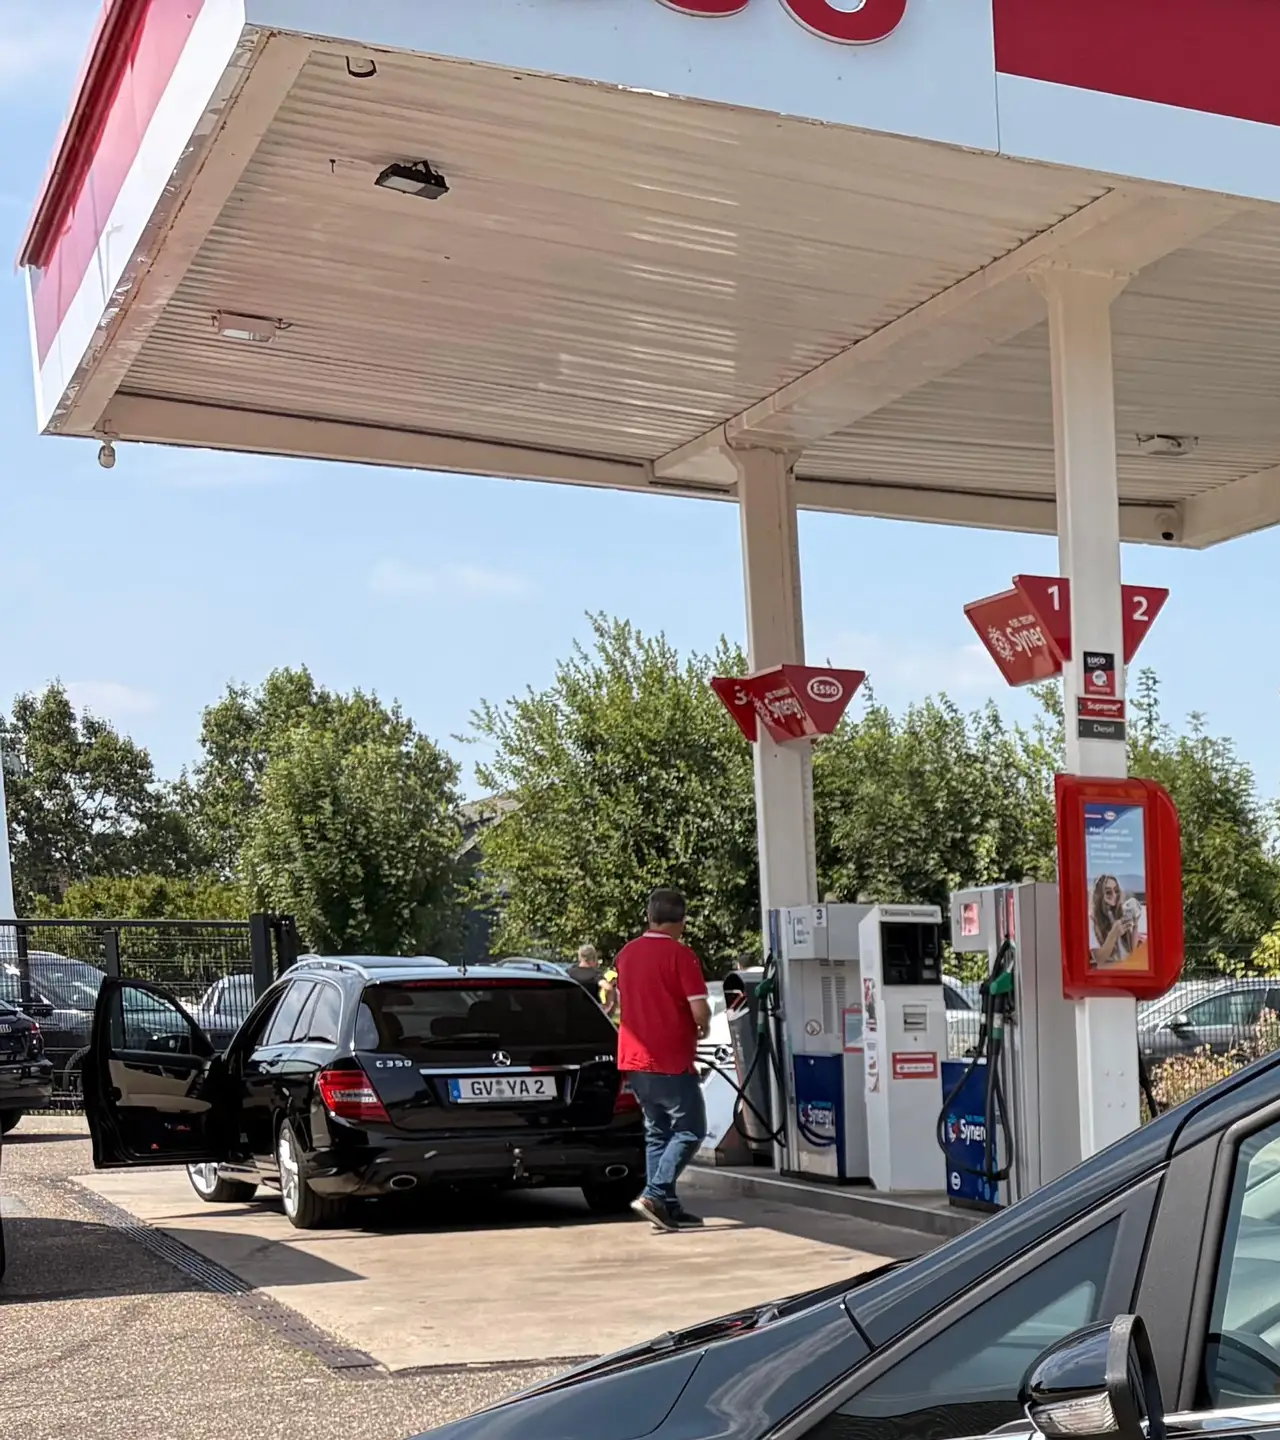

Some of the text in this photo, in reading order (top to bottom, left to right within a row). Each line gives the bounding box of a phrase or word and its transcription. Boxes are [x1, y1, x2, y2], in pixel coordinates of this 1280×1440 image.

[1047, 585, 1060, 611] 1
[1132, 595, 1149, 622] 2
[1006, 625, 1047, 658] Syner
[734, 685, 748, 706] 3
[812, 682, 838, 695] Esso
[1093, 724, 1115, 734] Diesel
[816, 908, 823, 920] 3
[471, 1079, 546, 1097] GV YA 2
